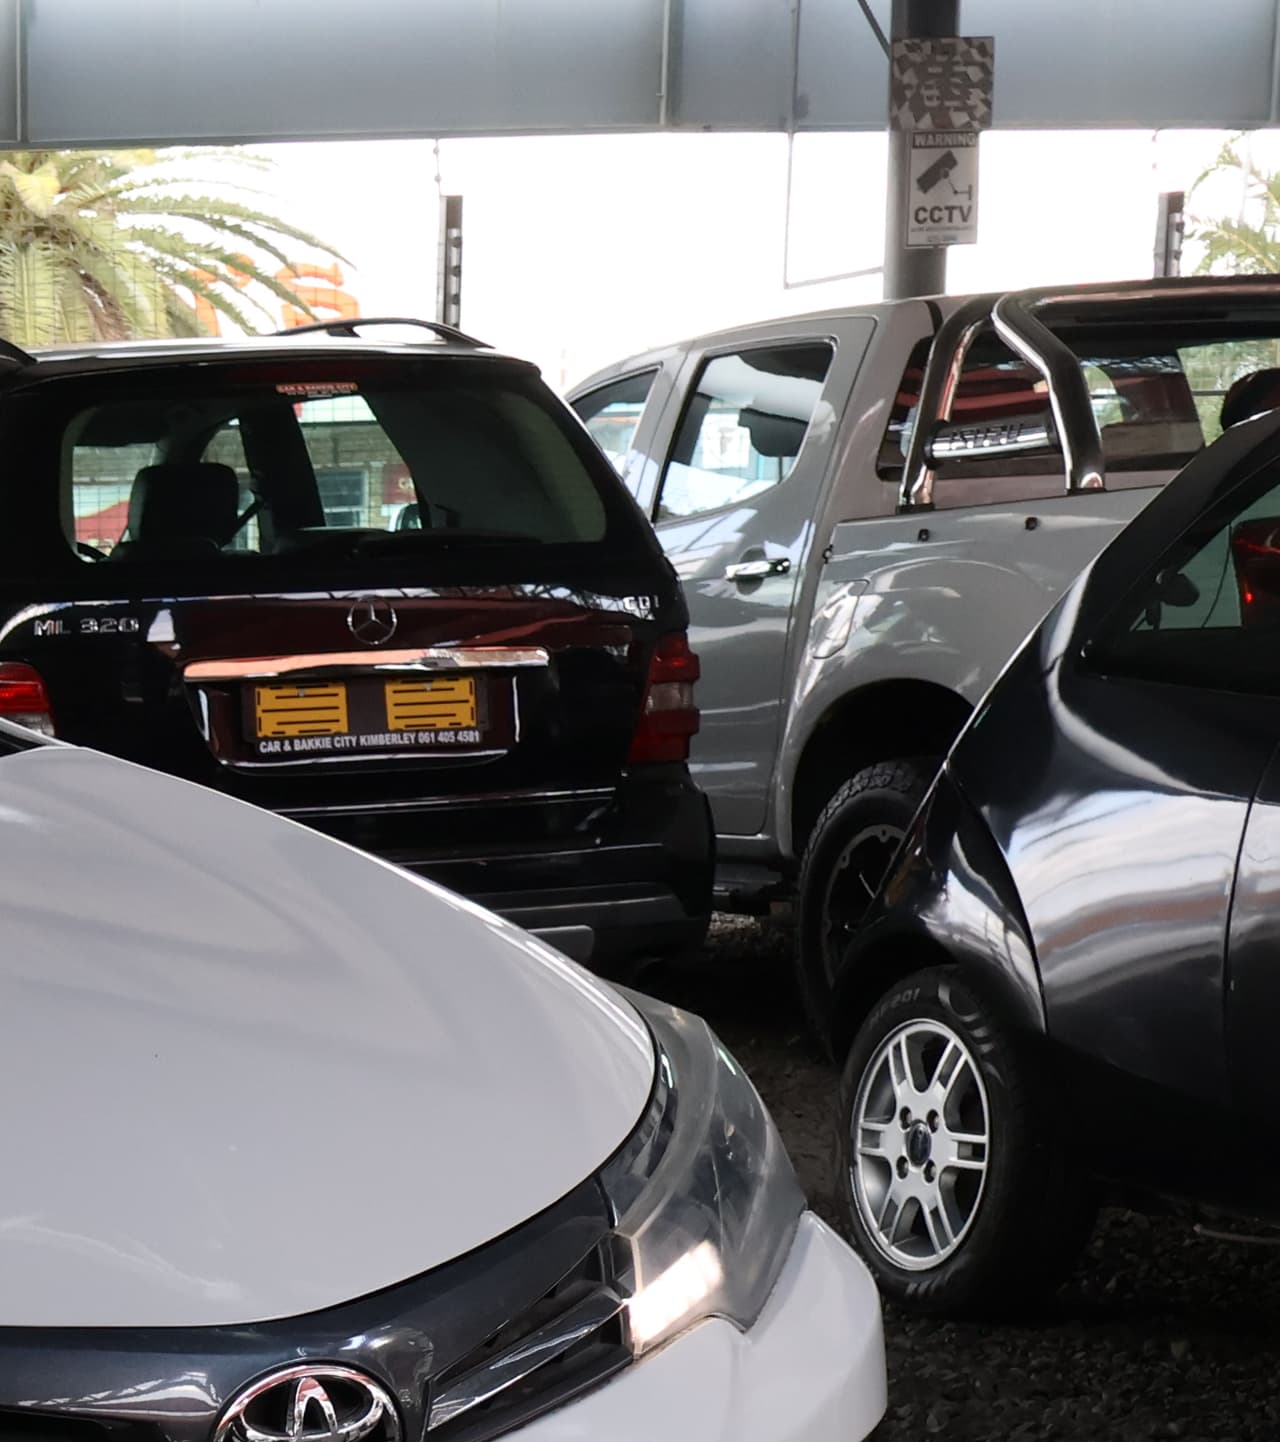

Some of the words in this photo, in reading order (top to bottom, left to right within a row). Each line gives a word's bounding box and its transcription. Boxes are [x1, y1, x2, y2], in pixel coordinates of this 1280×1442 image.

[914, 132, 976, 147] WARNING
[914, 205, 972, 224] CCTV
[623, 595, 660, 610] CDI
[34, 620, 72, 636] ML
[80, 617, 140, 633] 320
[259, 741, 281, 753] CAR
[283, 740, 291, 751] &
[294, 737, 332, 750] BAKKIE
[333, 734, 358, 748] CITY
[359, 732, 416, 746] KIMBERLEY
[418, 731, 436, 743] 061
[437, 730, 455, 743] 405
[456, 730, 480, 743] 4581
